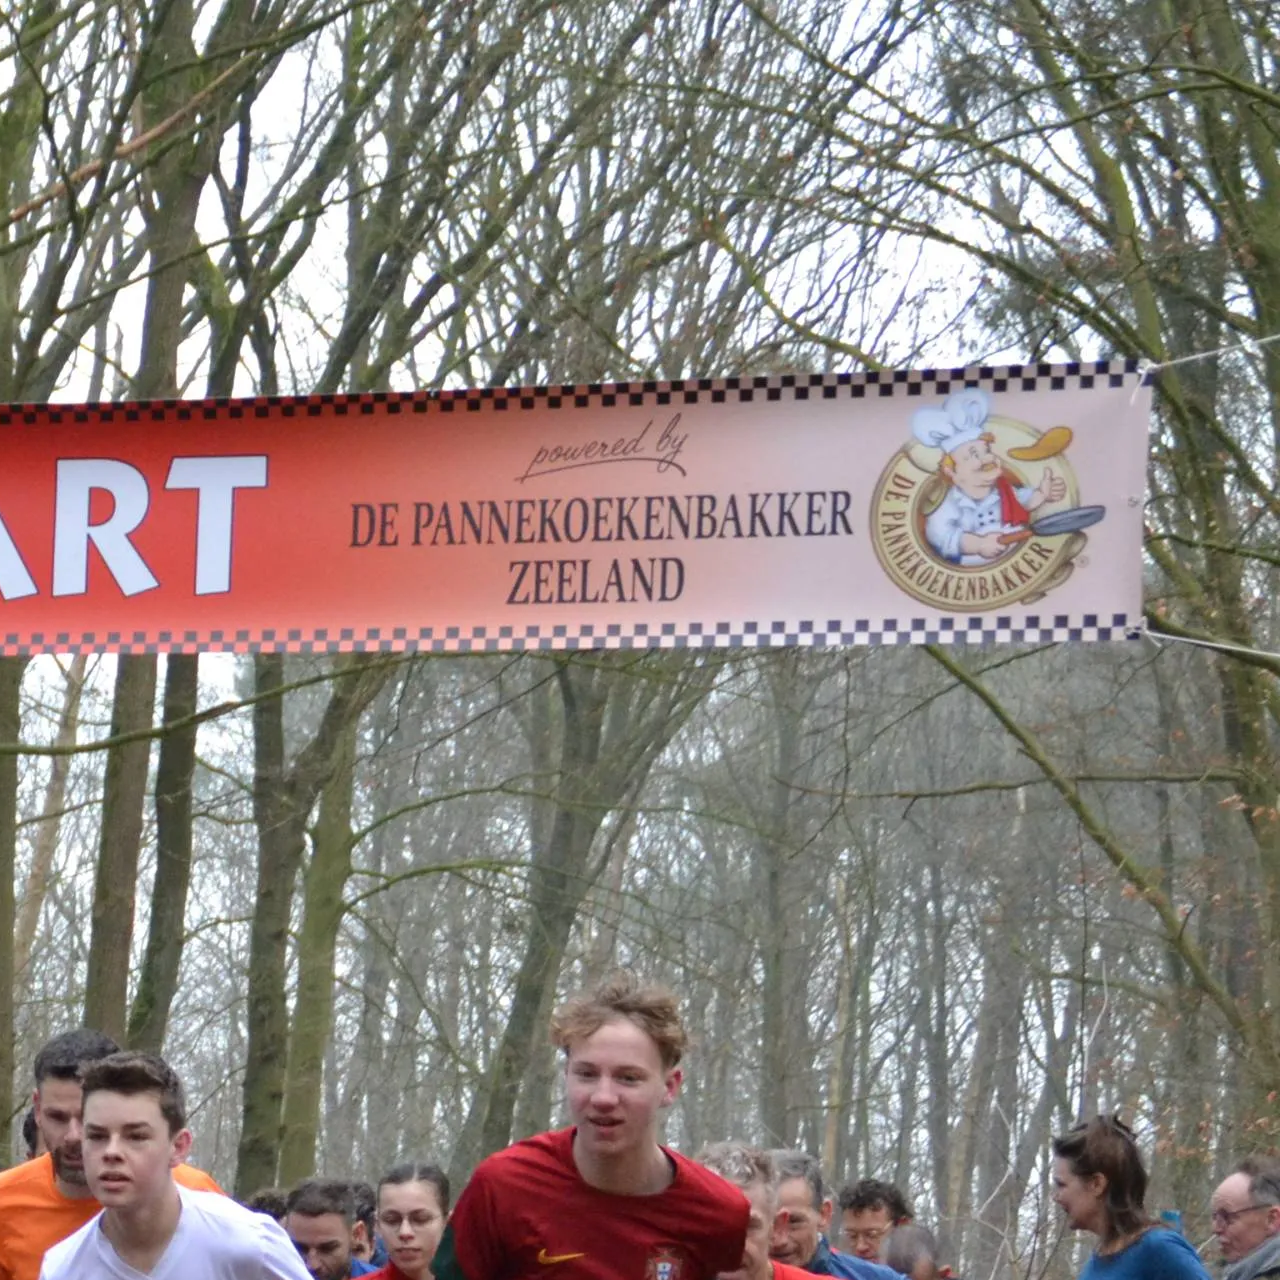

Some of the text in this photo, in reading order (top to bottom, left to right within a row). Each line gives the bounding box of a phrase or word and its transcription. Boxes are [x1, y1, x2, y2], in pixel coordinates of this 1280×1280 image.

[519, 412, 690, 484] powered by
[350, 489, 855, 548] DE PANNEKOEKENBAKKER
[880, 472, 1054, 602] DE PANNEKOEKENBAKKER
[506, 556, 686, 605] ZEELAND
